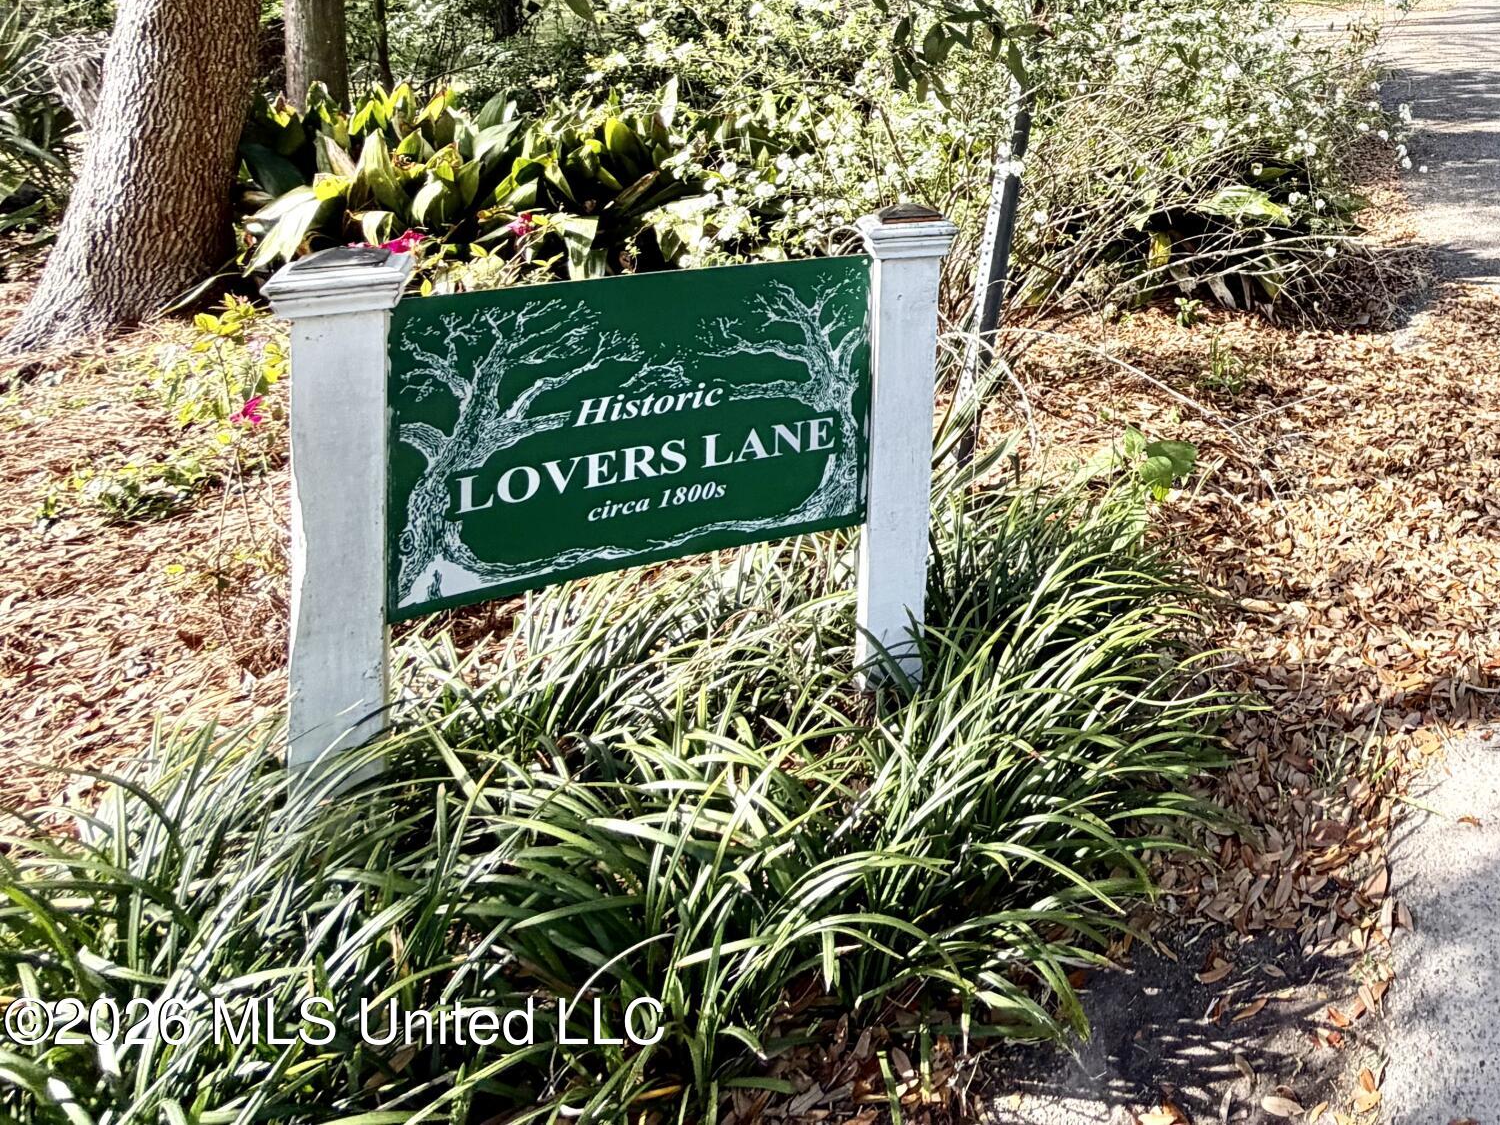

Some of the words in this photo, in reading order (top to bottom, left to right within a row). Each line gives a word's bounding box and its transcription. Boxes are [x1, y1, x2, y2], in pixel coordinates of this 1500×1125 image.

[573, 383, 723, 428] Historic
[455, 438, 687, 514] LOVERS
[701, 416, 836, 469] LANE
[587, 495, 650, 522] circa
[658, 481, 727, 509] 1800s
